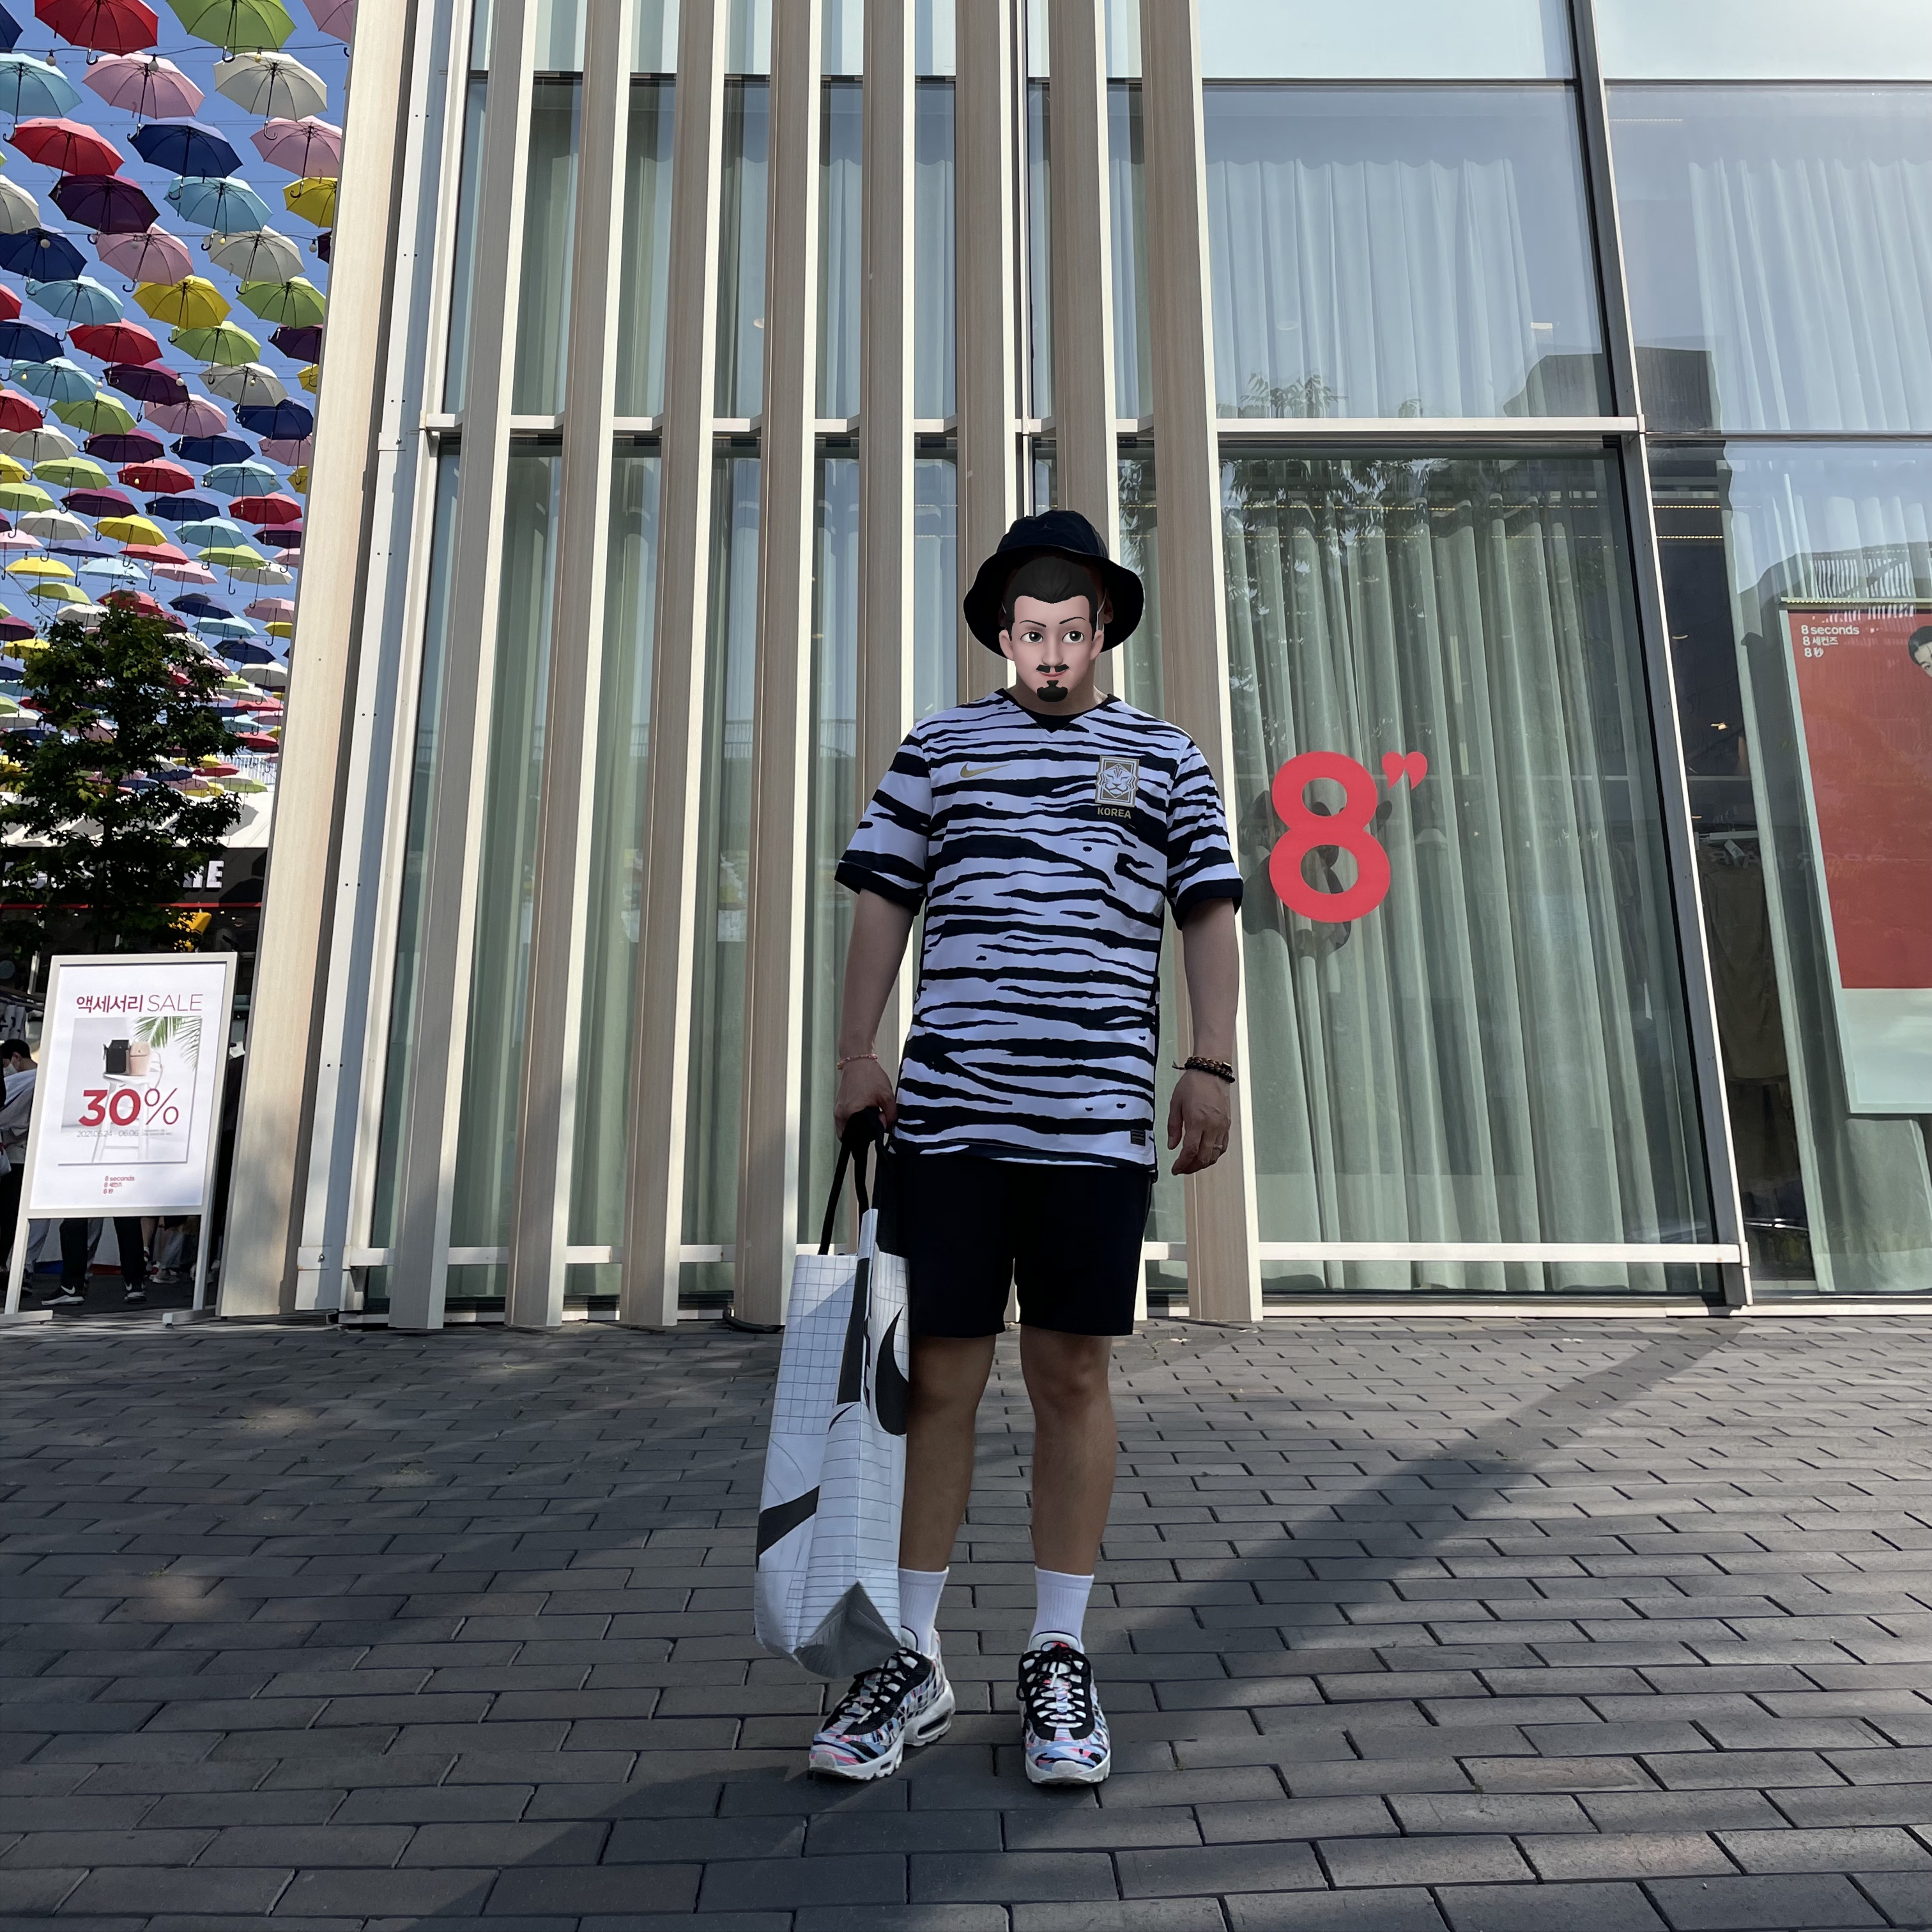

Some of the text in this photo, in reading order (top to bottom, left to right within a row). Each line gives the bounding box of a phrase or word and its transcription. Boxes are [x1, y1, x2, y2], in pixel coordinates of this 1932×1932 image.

[1801, 625, 1860, 635] 8 seconds
[1803, 636, 1811, 646] 8
[1804, 647, 1813, 657] 8
[1097, 807, 1131, 819] KOREA
[76, 993, 203, 1013] 액세서리 SALE
[78, 1087, 178, 1126] 30%
